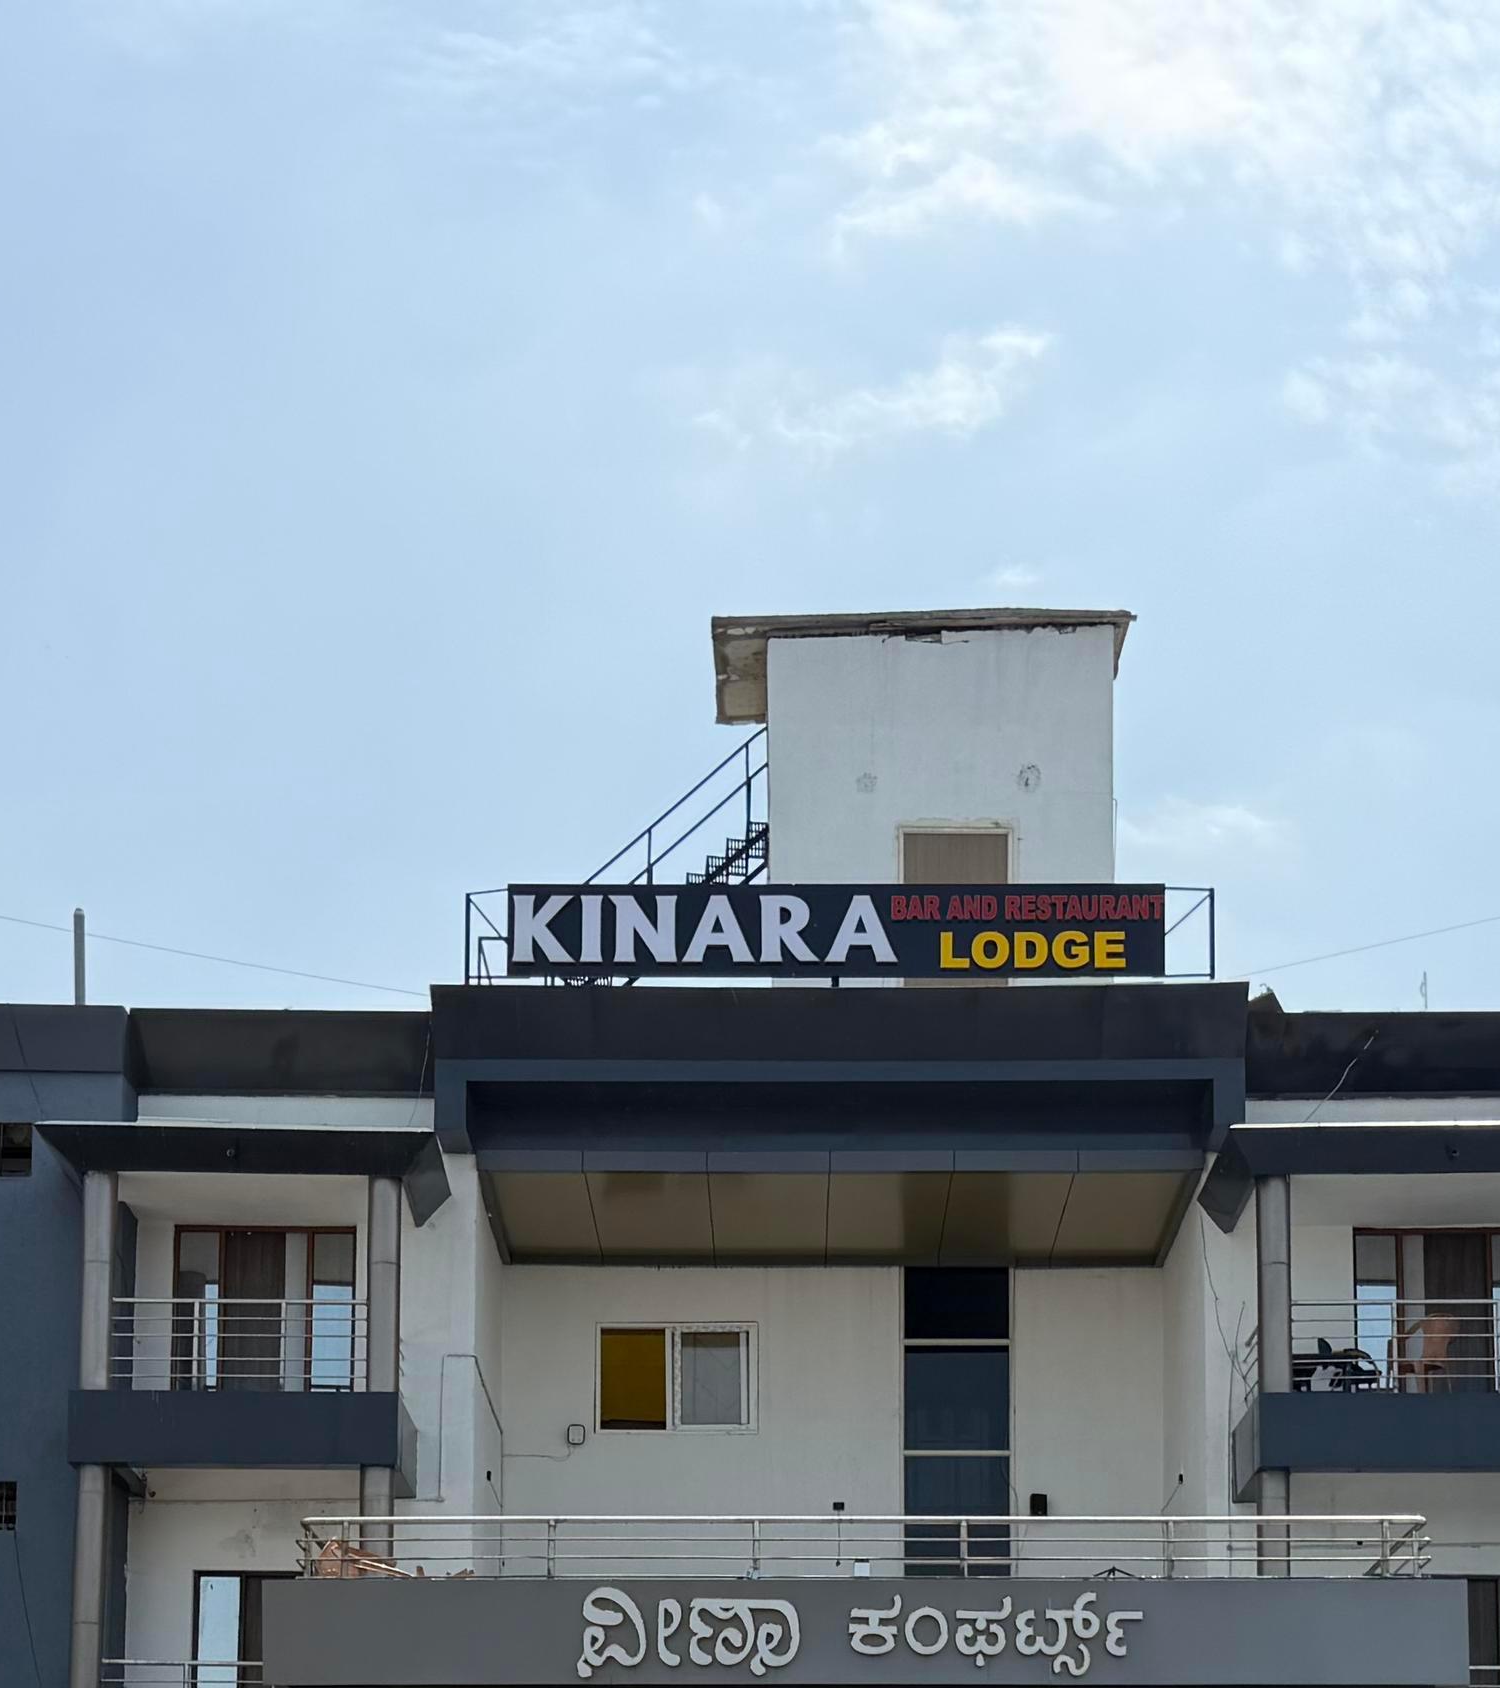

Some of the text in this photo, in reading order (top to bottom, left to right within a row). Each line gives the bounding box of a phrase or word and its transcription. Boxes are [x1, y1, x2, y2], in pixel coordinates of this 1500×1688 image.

[890, 894, 1165, 921] BAR AND RESTAURANT
[511, 894, 898, 963] KINARA
[939, 930, 1127, 969] LODGE
